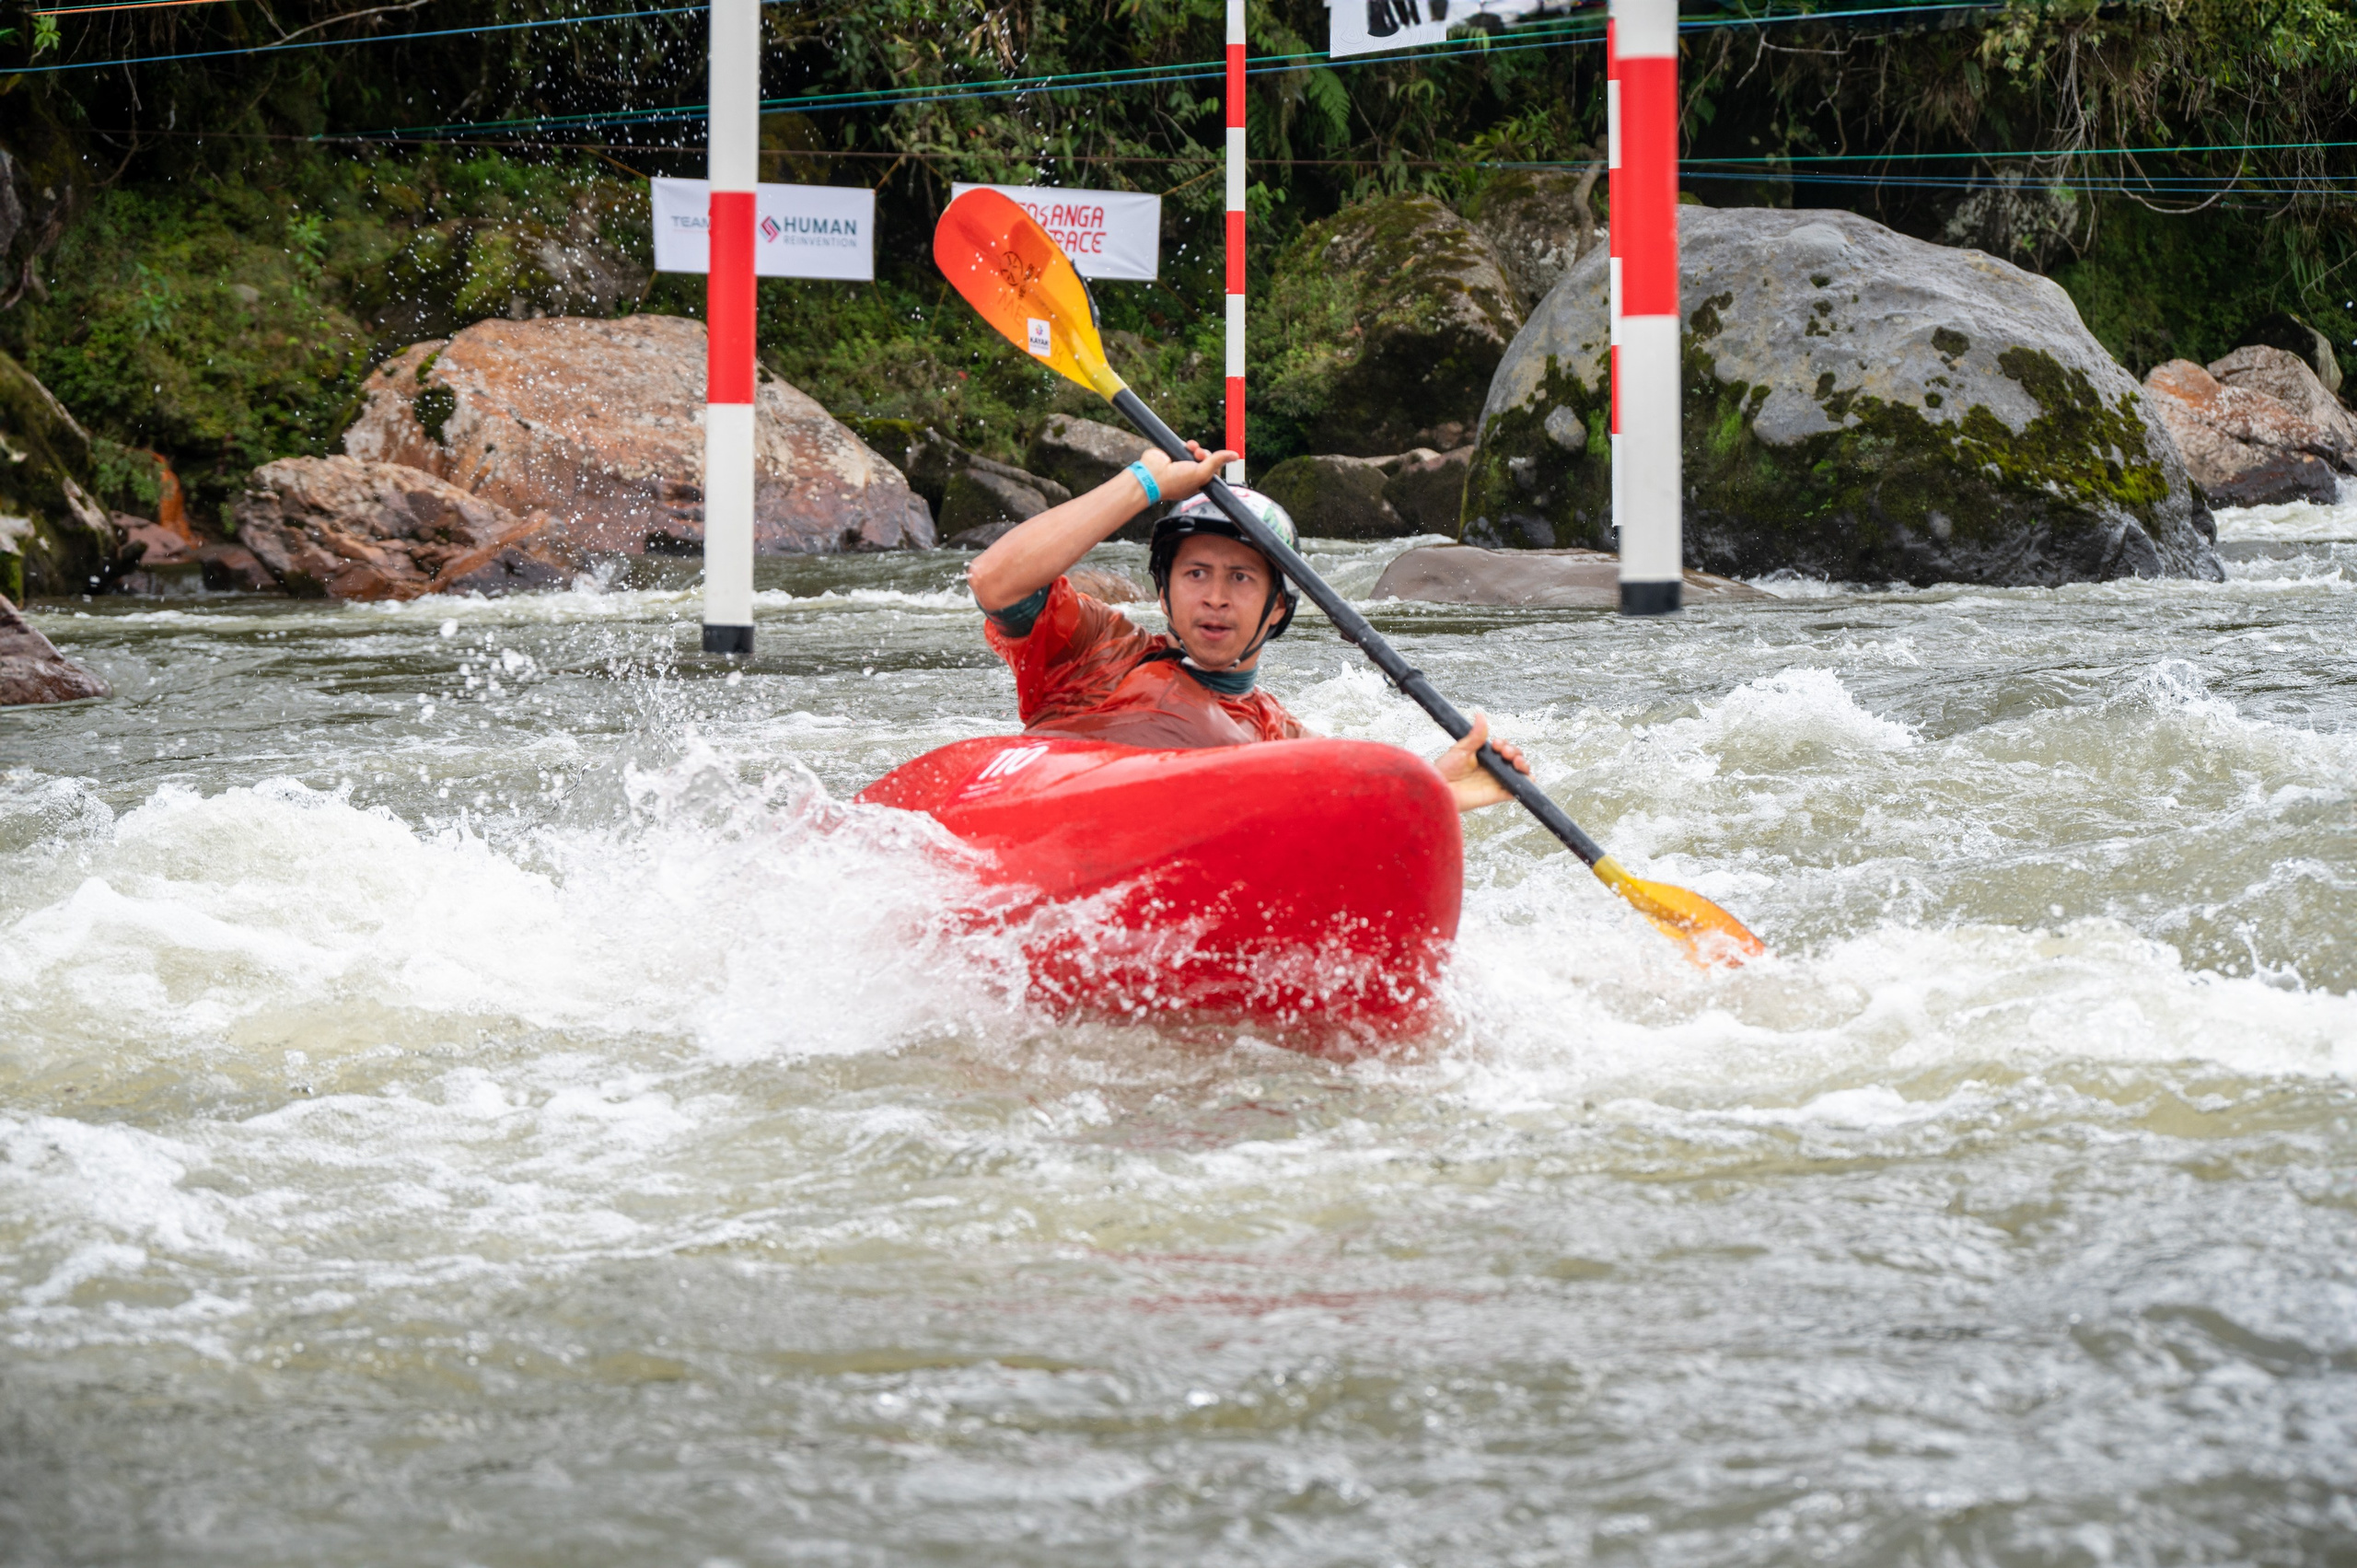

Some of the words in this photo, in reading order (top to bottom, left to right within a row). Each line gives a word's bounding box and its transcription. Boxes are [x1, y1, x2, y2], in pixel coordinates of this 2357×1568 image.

[1017, 202, 1104, 228] OSANGA
[784, 216, 857, 236] HUMAN
[784, 236, 857, 248] REINVENTION
[1029, 336, 1049, 346] KAYAK
